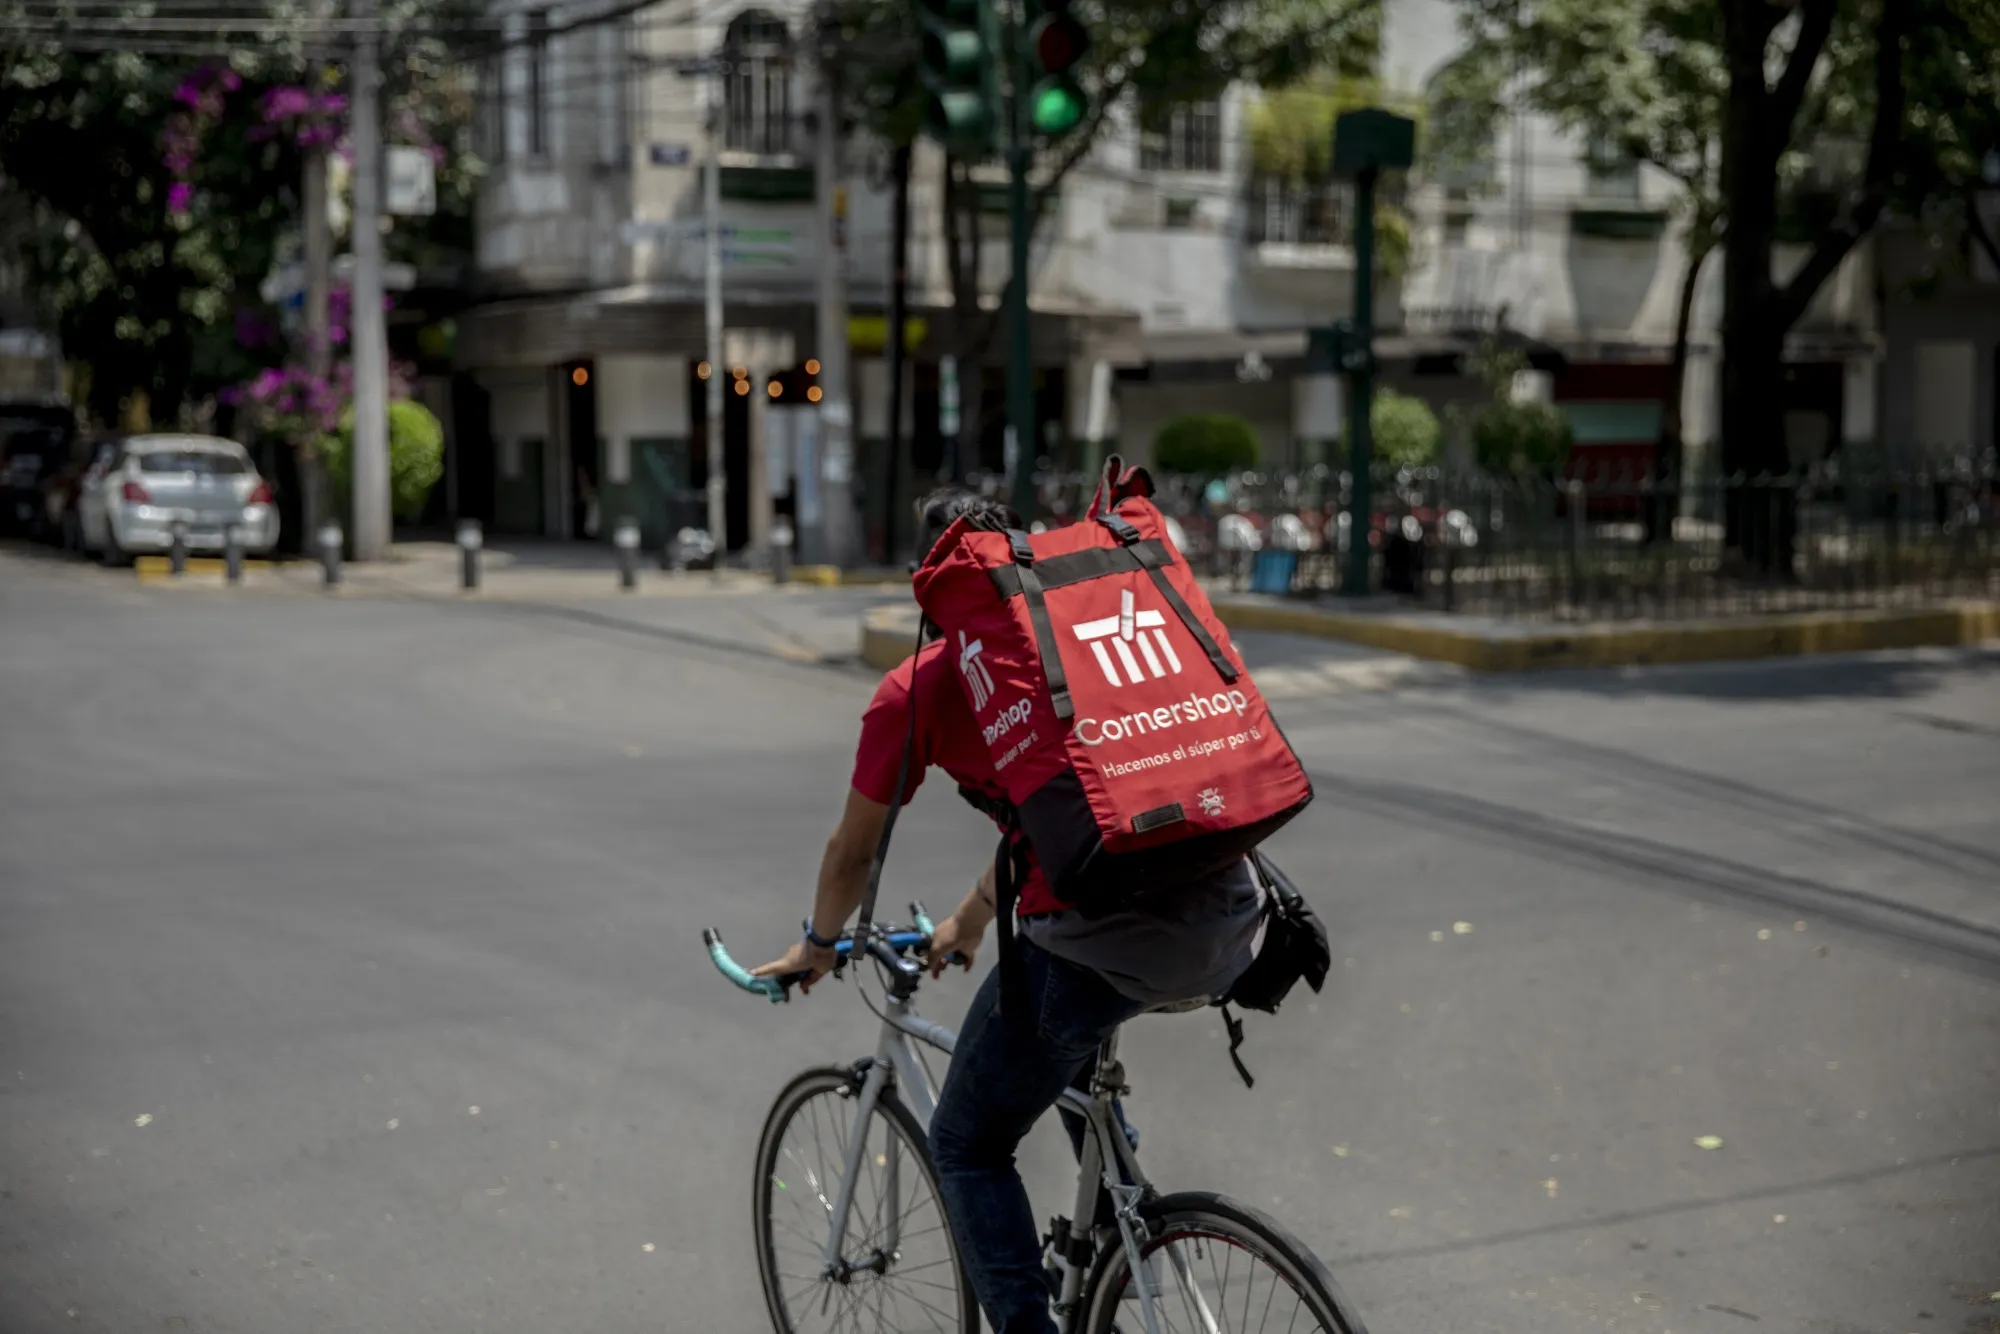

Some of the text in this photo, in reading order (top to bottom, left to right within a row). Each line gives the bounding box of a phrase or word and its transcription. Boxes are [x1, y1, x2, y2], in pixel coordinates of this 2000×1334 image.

[1074, 689, 1248, 746] Cornershop
[1102, 725, 1262, 779] Hacemos el súper por ti
